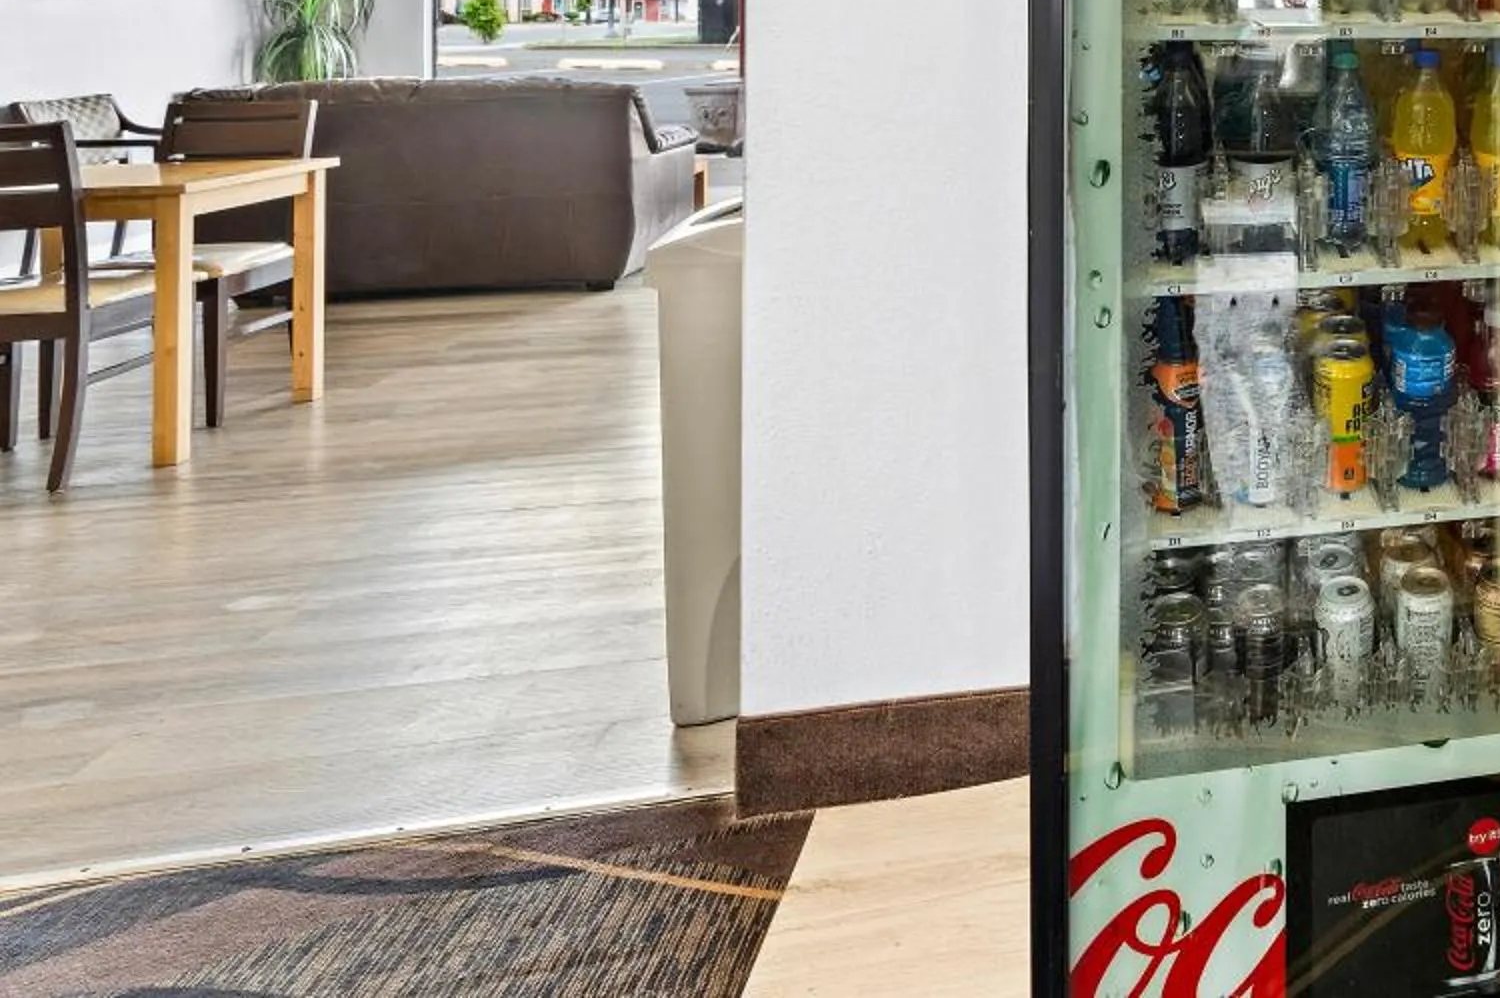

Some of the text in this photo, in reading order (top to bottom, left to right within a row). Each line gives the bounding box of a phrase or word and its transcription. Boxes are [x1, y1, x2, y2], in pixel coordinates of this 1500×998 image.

[1469, 832, 1488, 844] try
[1327, 891, 1352, 907] real
[1401, 880, 1429, 893] taste
[1361, 888, 1437, 909] zero calories
[1477, 891, 1492, 947] zero
